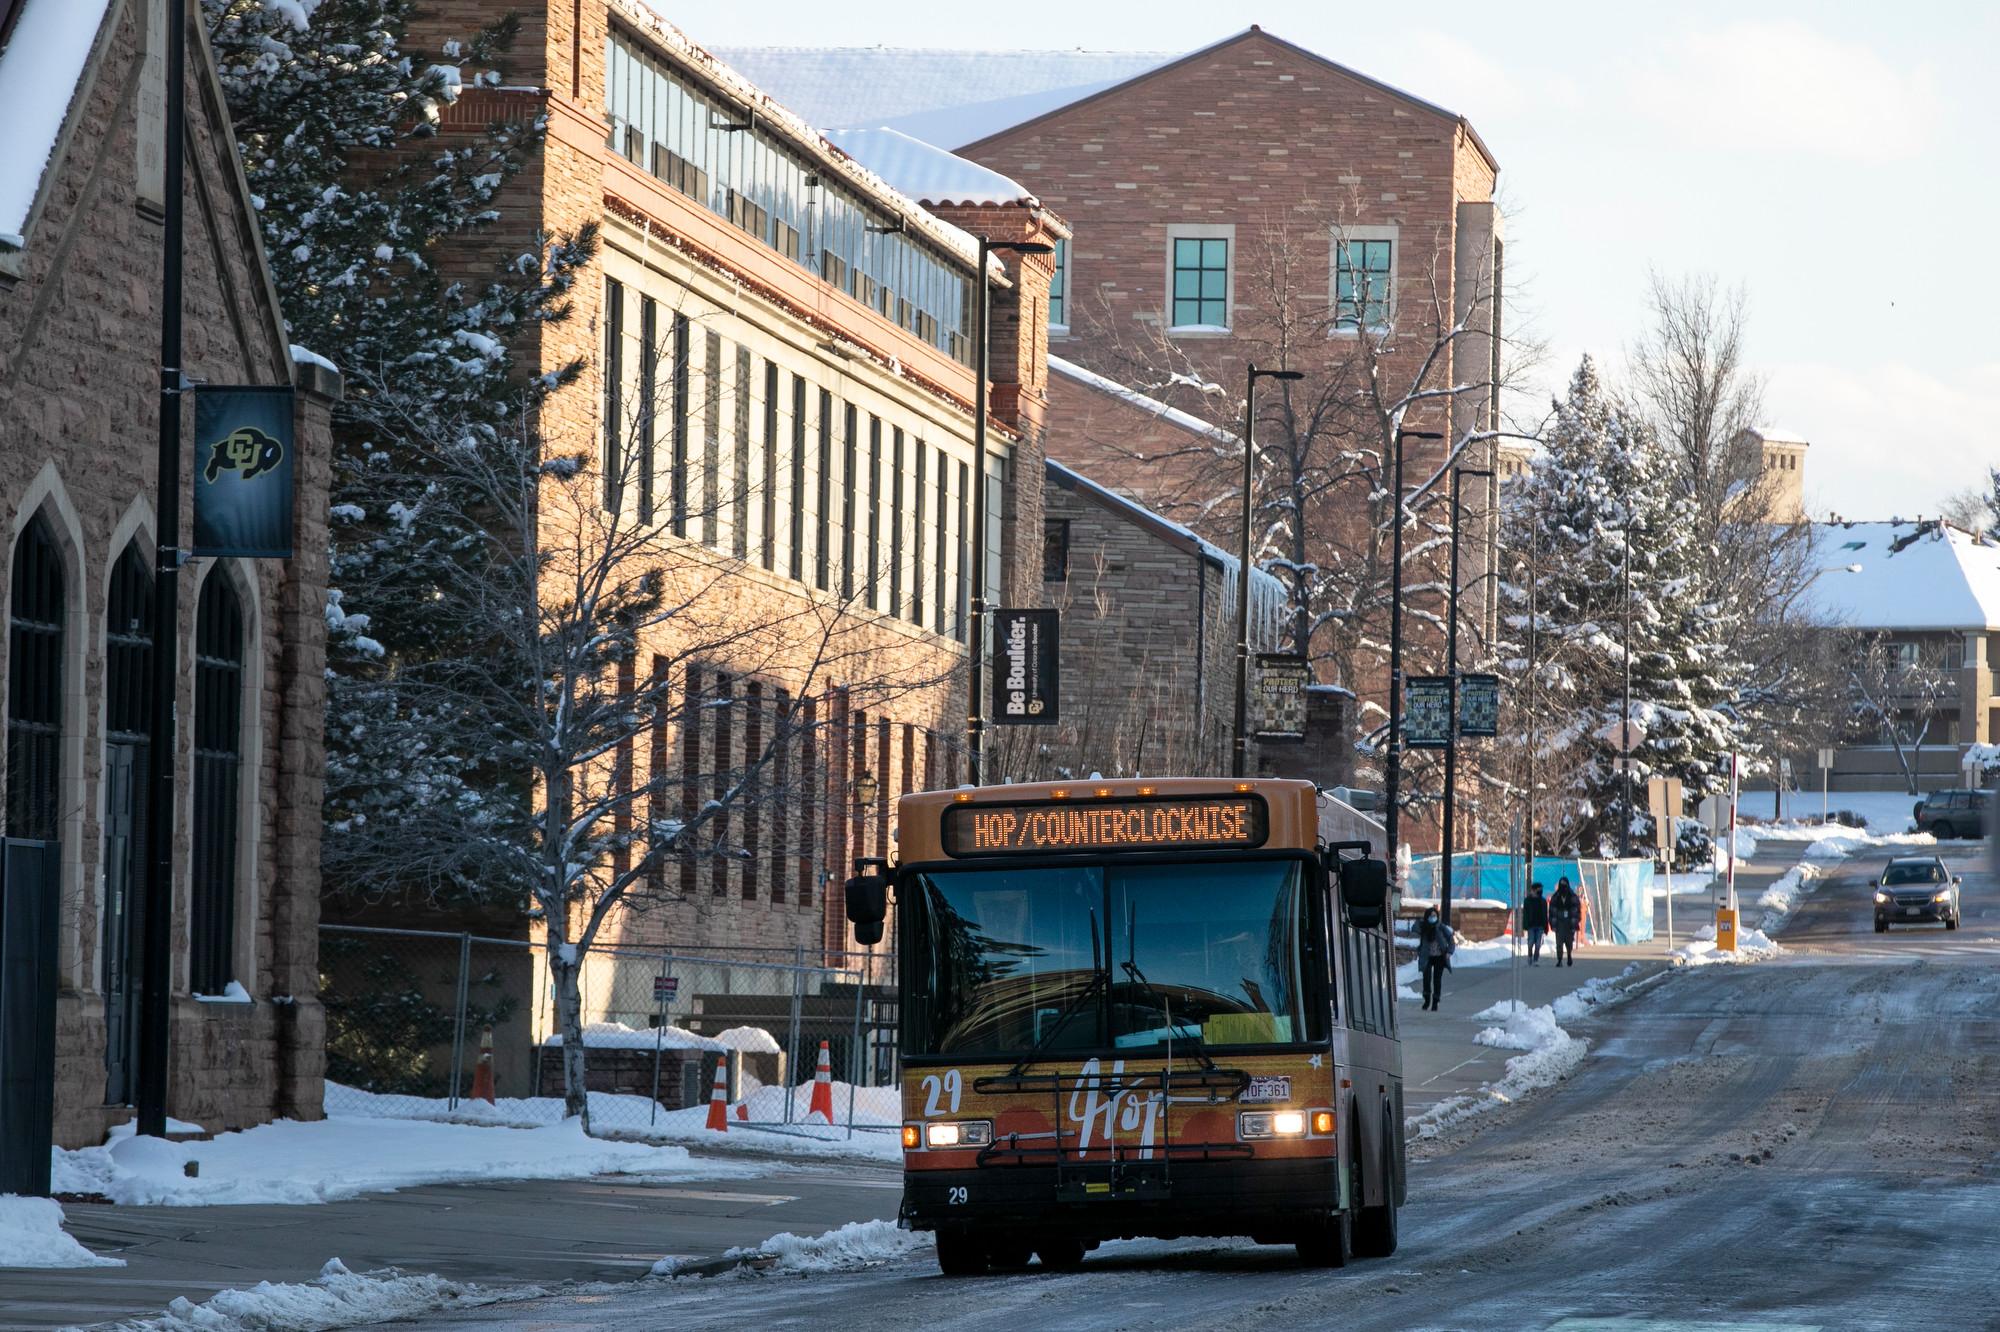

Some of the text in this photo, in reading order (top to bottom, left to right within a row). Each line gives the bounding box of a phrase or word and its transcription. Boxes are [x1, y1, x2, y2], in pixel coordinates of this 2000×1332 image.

[227, 433, 263, 469] CU
[1006, 616, 1026, 715] Be Boulder.
[975, 805, 1248, 848] HOP/COUNTERCLOCKWISE
[921, 1069, 963, 1117] 29
[949, 1187, 968, 1205] 29
